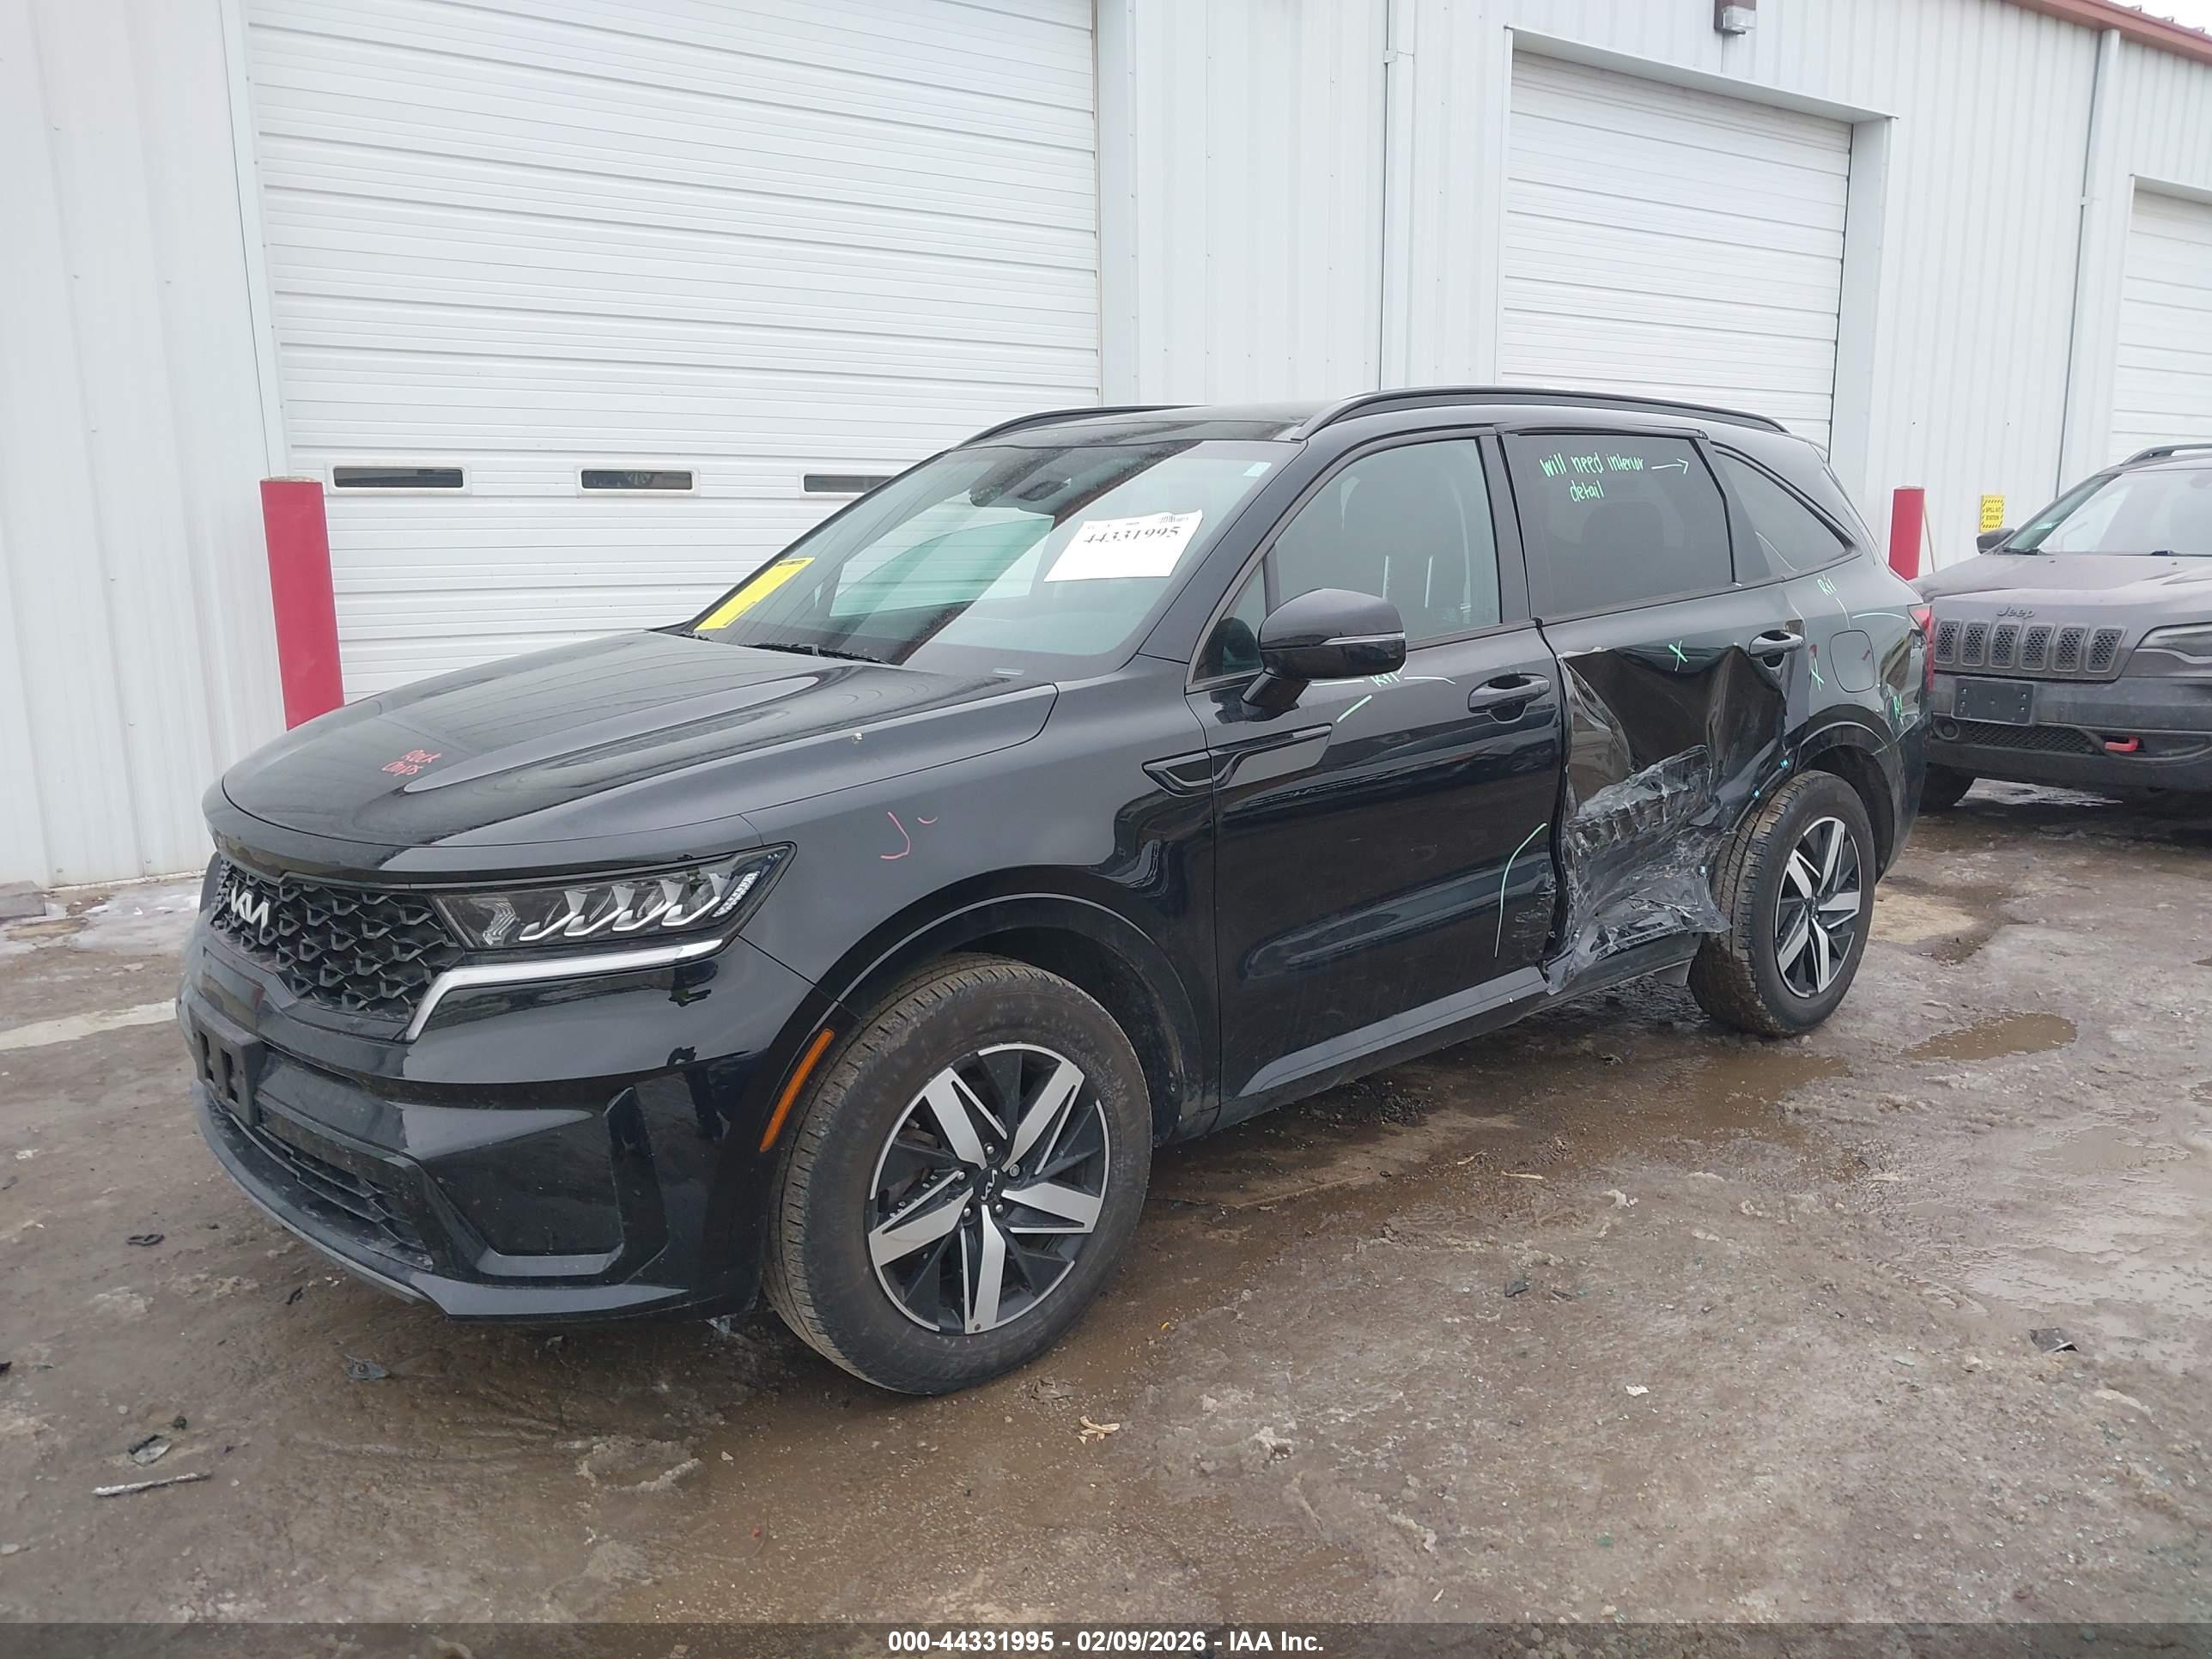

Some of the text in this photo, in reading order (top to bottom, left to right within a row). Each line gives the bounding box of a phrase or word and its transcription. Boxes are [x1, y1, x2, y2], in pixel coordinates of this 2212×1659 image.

[1571, 452, 1604, 474] need
[1570, 479, 1605, 502] detail
[1084, 526, 1182, 544] 44331995
[1996, 606, 2034, 619] Jeep
